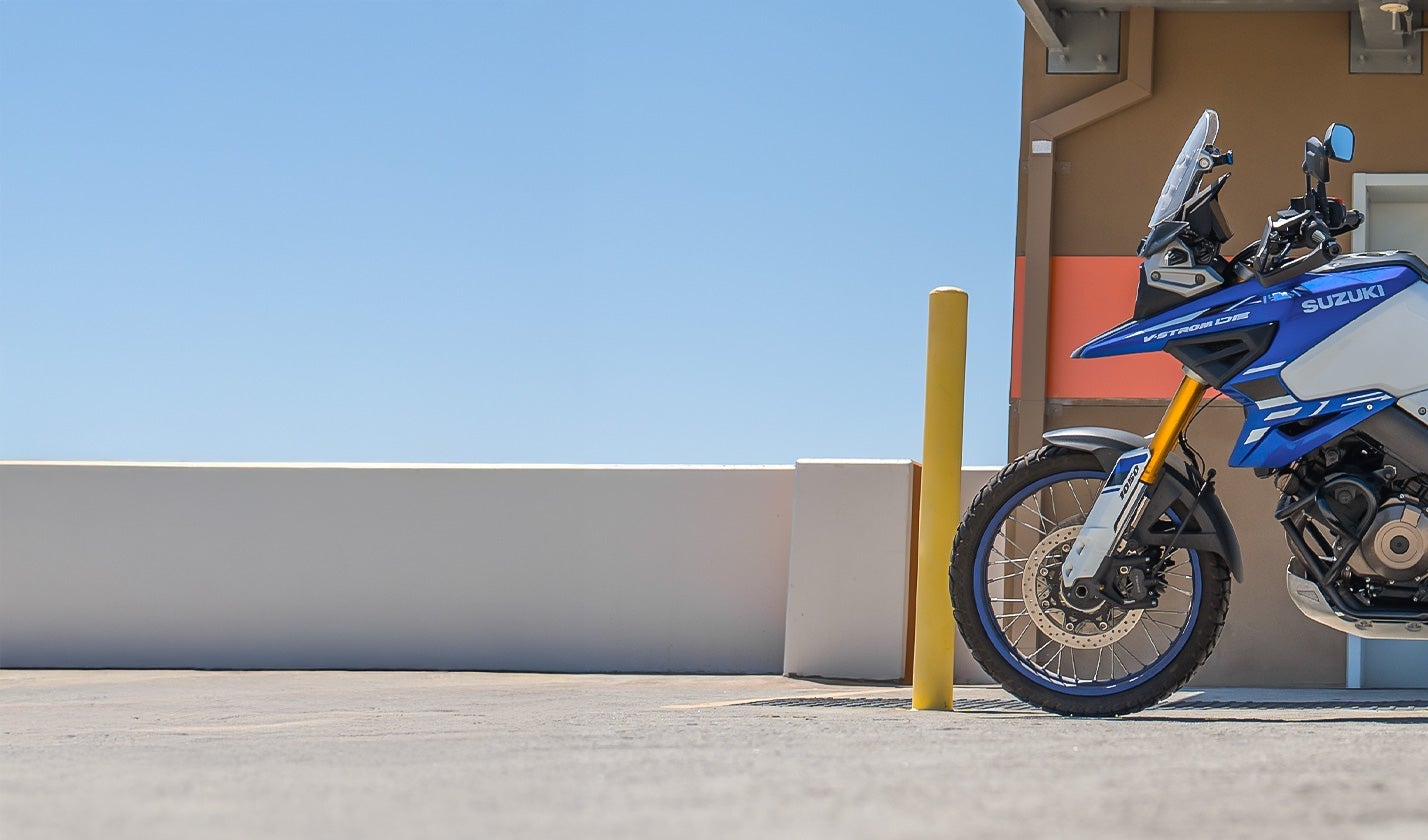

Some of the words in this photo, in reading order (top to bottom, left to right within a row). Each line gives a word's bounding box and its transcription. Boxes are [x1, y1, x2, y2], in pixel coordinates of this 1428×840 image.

[1301, 284, 1385, 314] SUZUKI
[1143, 320, 1213, 343] V-STROM
[1214, 311, 1251, 326] DE
[1120, 464, 1140, 500] 1050
